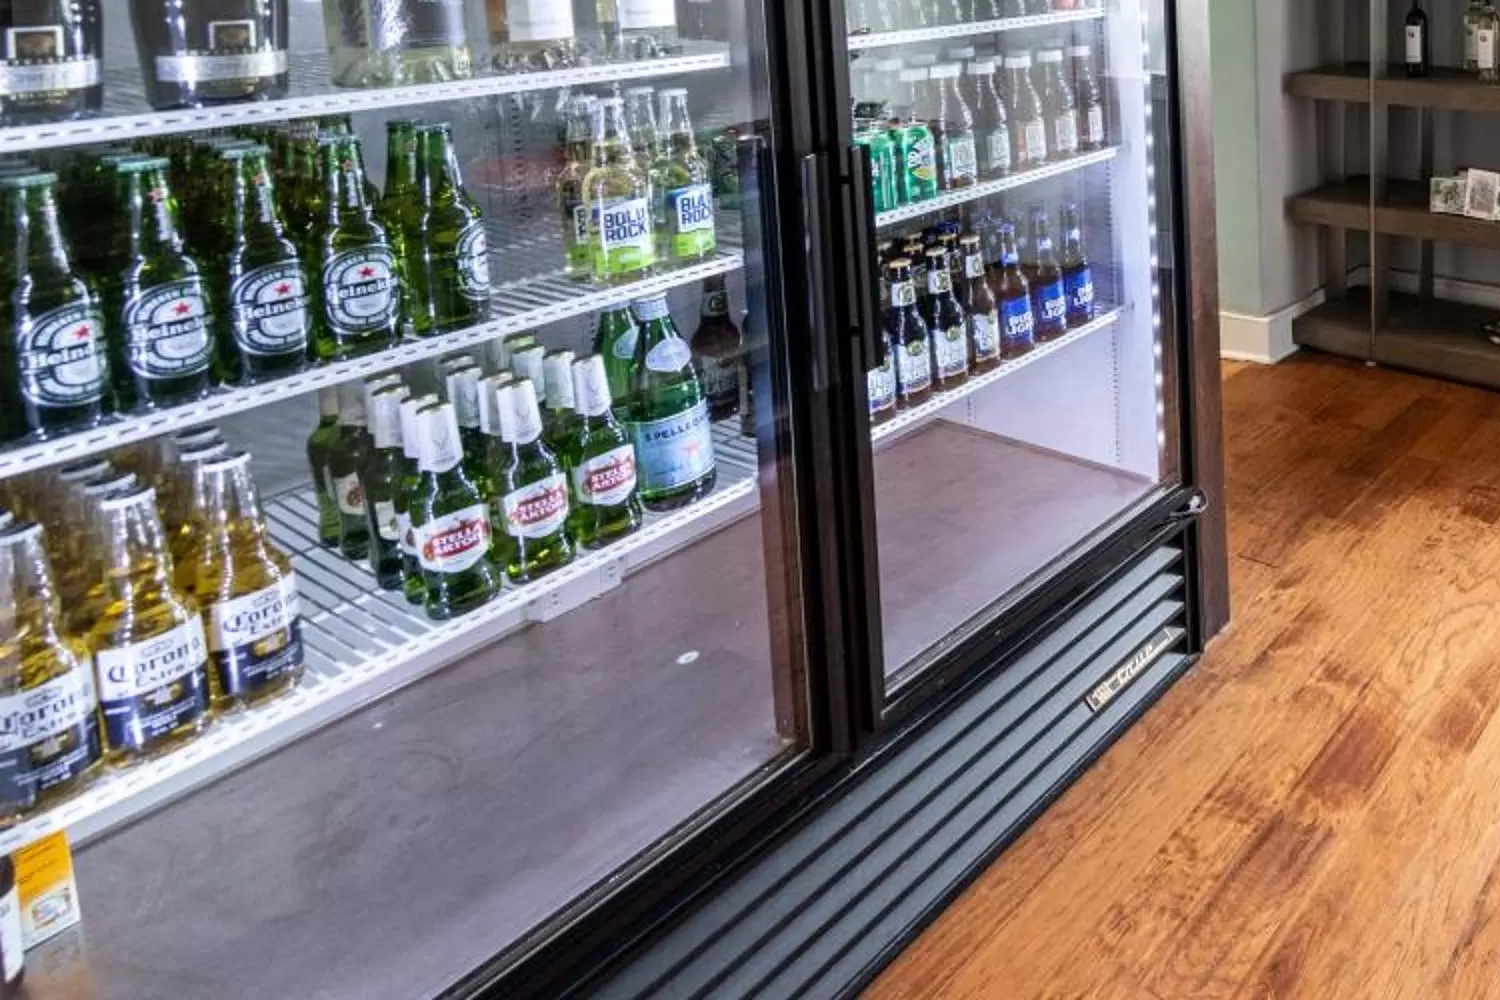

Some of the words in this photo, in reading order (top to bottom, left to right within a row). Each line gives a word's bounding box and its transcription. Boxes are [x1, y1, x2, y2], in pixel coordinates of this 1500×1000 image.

[604, 222, 648, 242] ROCK
[325, 275, 398, 300] Heineke
[240, 297, 306, 321] Heinek
[131, 316, 207, 341] Heinek
[28, 342, 97, 369] Heine
